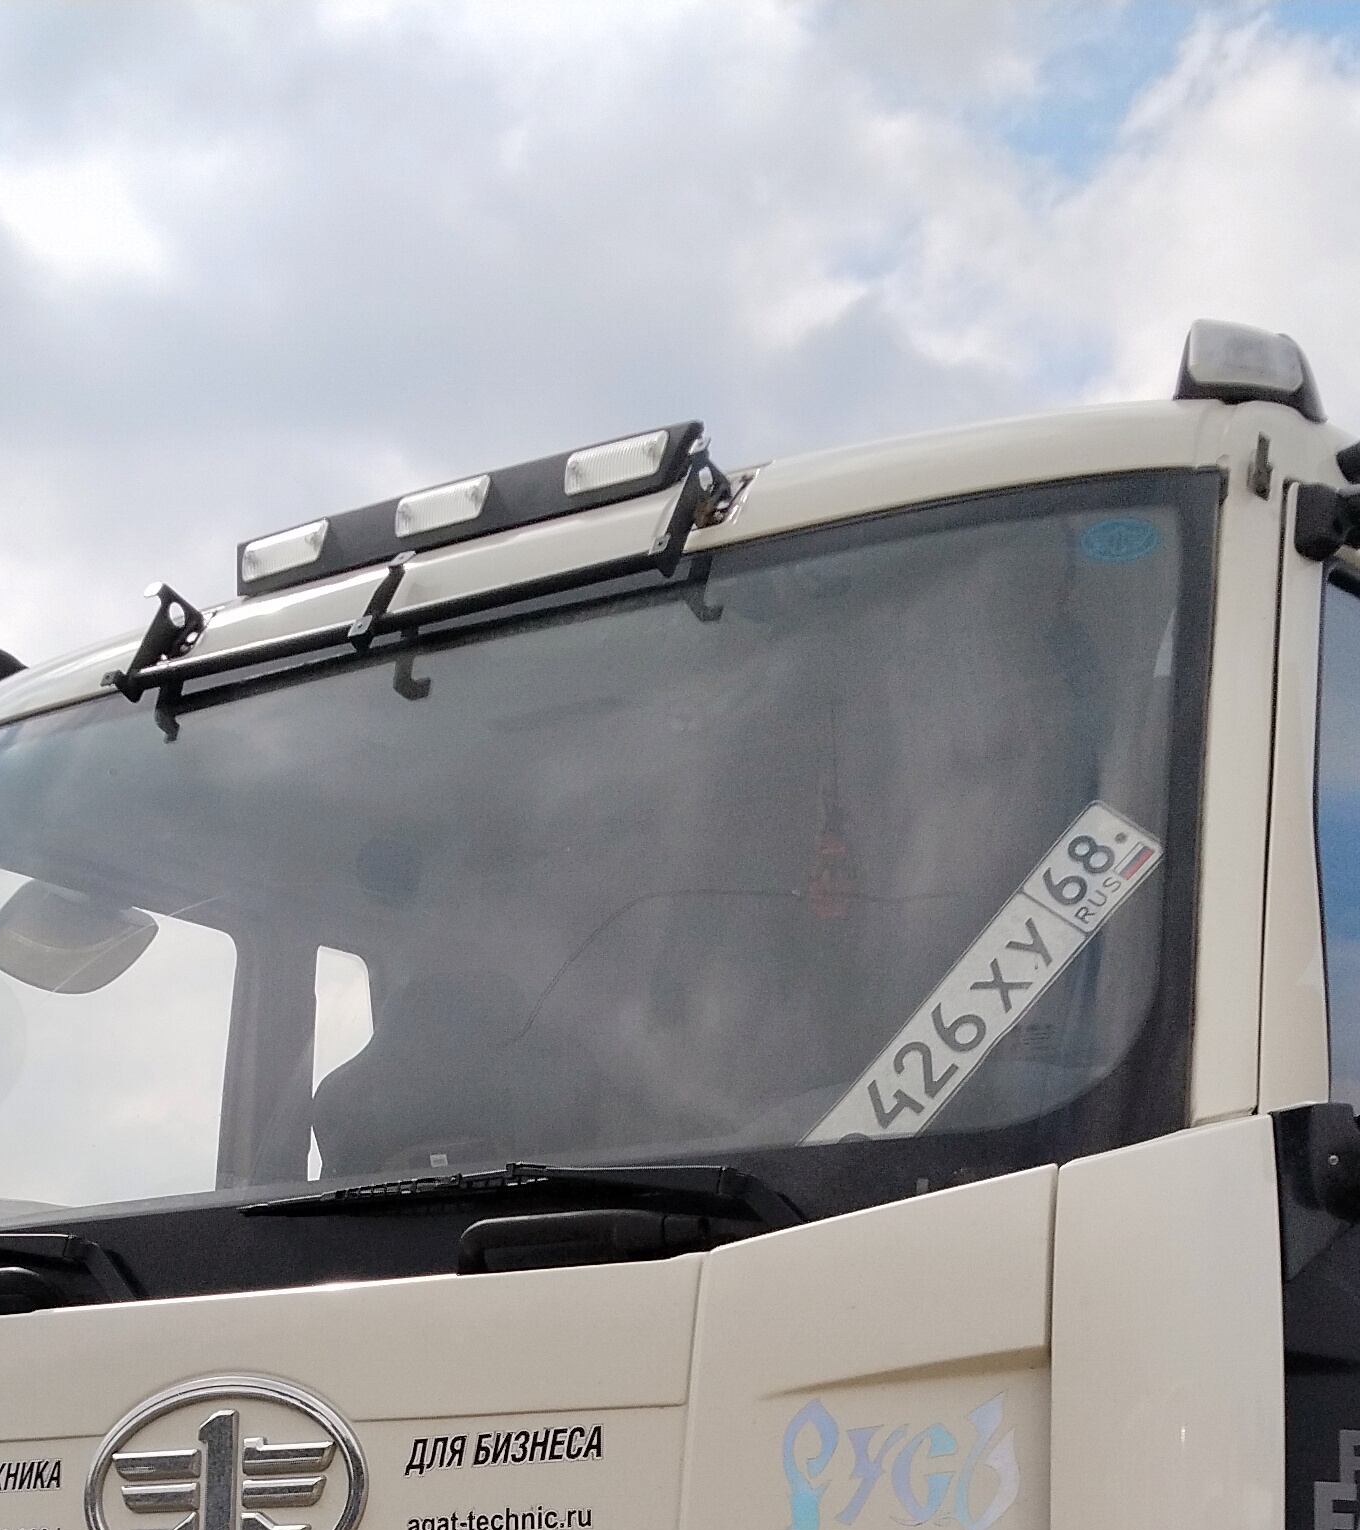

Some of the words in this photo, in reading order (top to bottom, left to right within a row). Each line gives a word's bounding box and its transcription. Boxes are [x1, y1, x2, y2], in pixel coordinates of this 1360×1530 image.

[1042, 834, 1116, 906] 68
[1074, 876, 1123, 925] RUS
[404, 1434, 468, 1476] ДЛЯ
[472, 1425, 603, 1467] БИЗНЕСА
